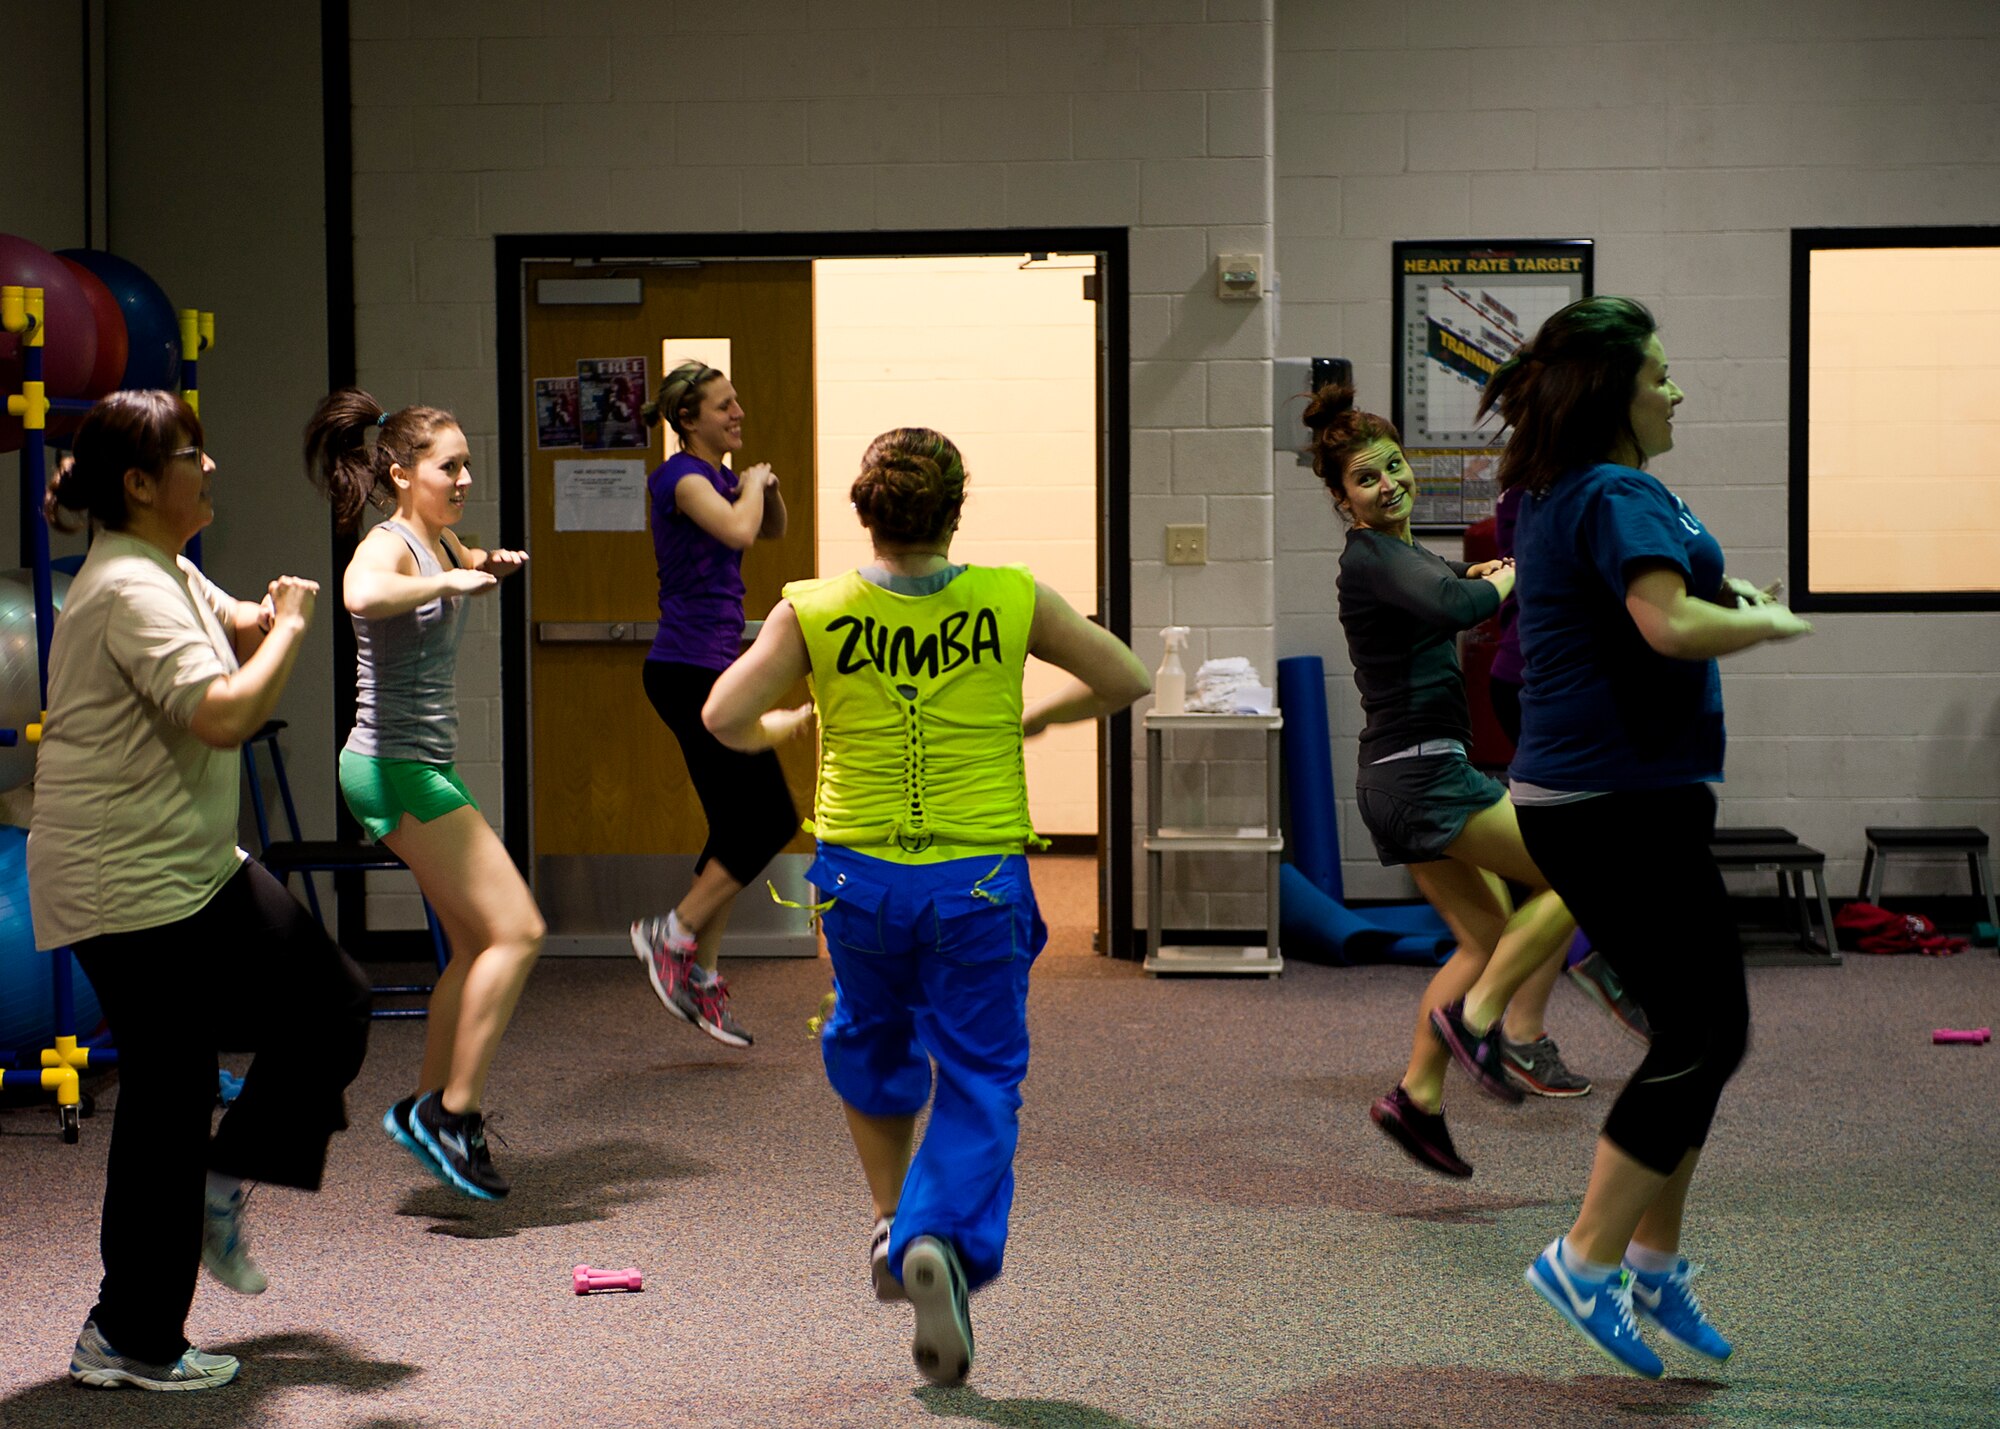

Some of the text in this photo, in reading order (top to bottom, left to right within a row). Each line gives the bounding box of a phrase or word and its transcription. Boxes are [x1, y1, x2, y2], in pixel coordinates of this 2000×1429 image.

[1404, 257, 1582, 273] HEART RATE TARGET
[1439, 328, 1501, 376] TRAININ
[597, 360, 642, 374] FREE
[549, 379, 577, 391] FREE
[825, 607, 1002, 679] ZUMBA
